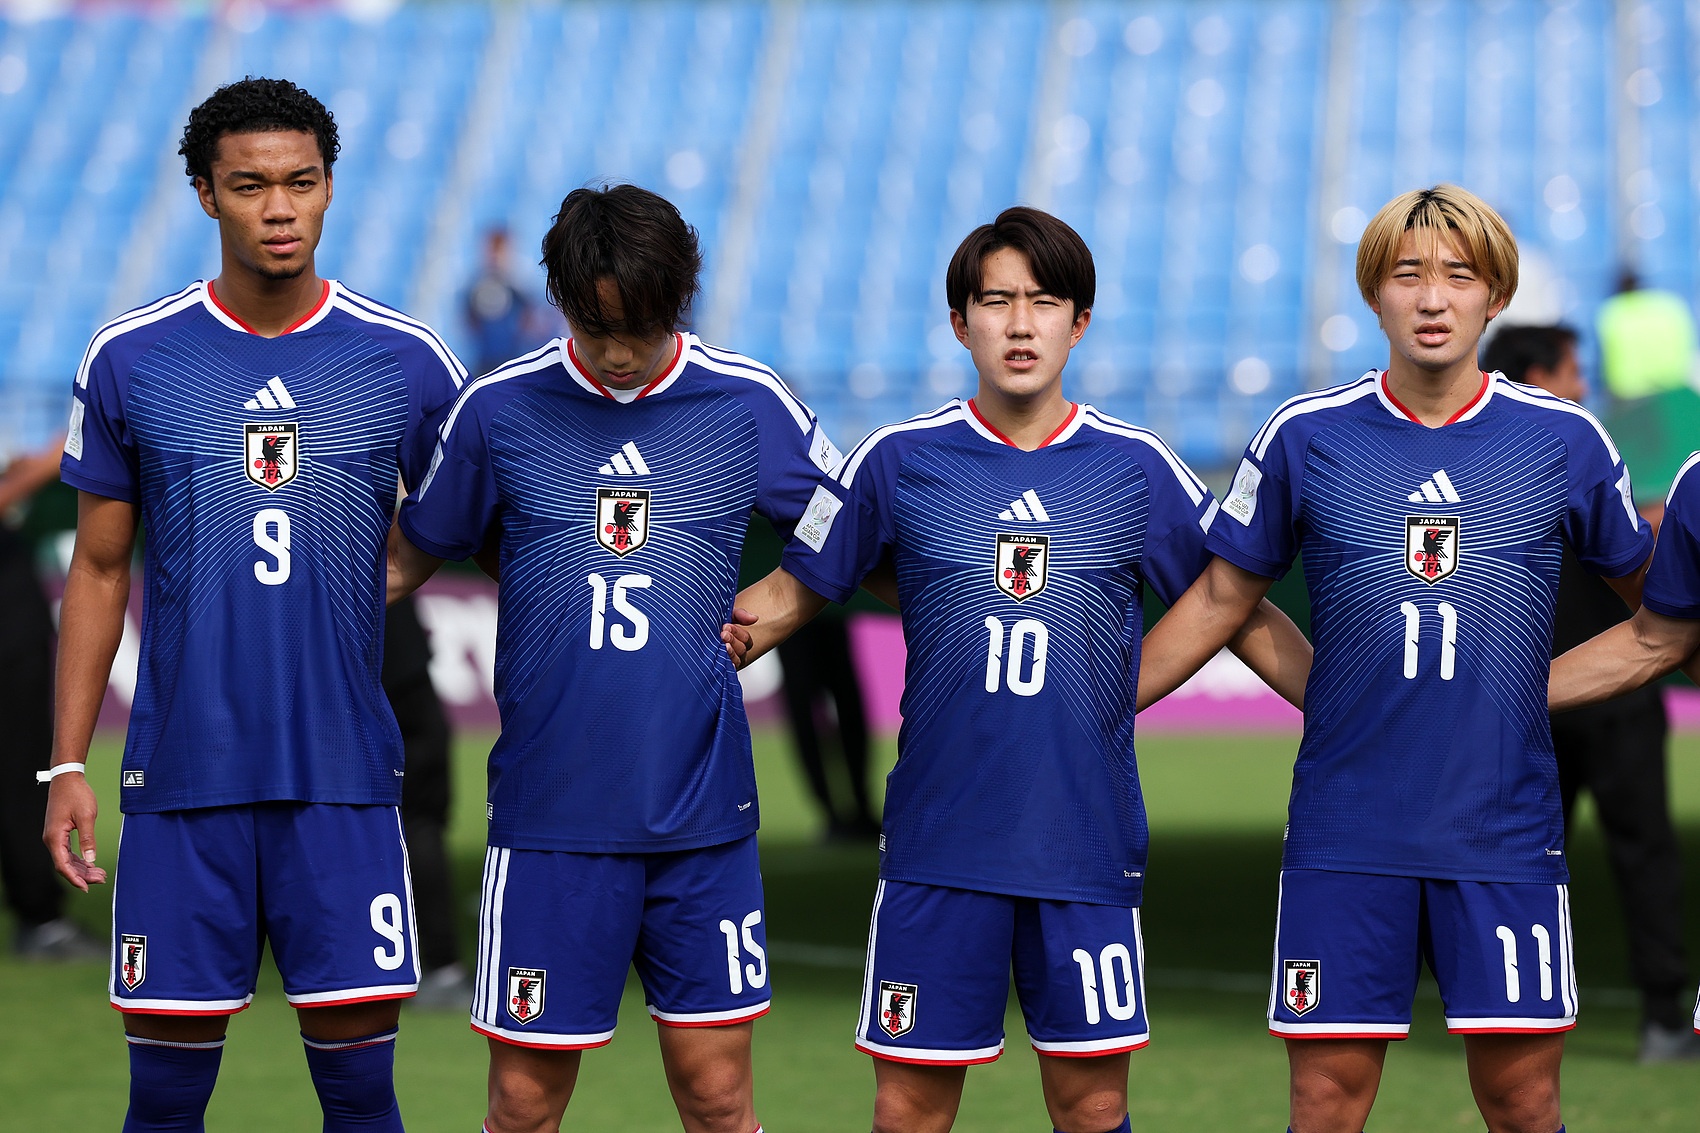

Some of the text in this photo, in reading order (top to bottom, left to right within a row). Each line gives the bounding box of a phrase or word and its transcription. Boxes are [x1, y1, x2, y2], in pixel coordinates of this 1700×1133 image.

[259, 467, 283, 480] JFA
[609, 490, 638, 498] JAPAN
[610, 534, 633, 546] JFA
[252, 508, 292, 586] 9
[1419, 562, 1442, 573] JFA
[1009, 580, 1032, 591] JFA
[587, 571, 653, 652] 15
[1400, 600, 1458, 681] 11
[984, 615, 1049, 697] 10
[370, 892, 404, 971] 9
[719, 909, 767, 995] 15
[1495, 923, 1553, 1003] 11
[126, 972, 137, 981] JFA
[1072, 942, 1137, 1025] 10
[1292, 997, 1308, 1007] JFA
[514, 1004, 532, 1015] JFA
[886, 1019, 903, 1029] JFA
